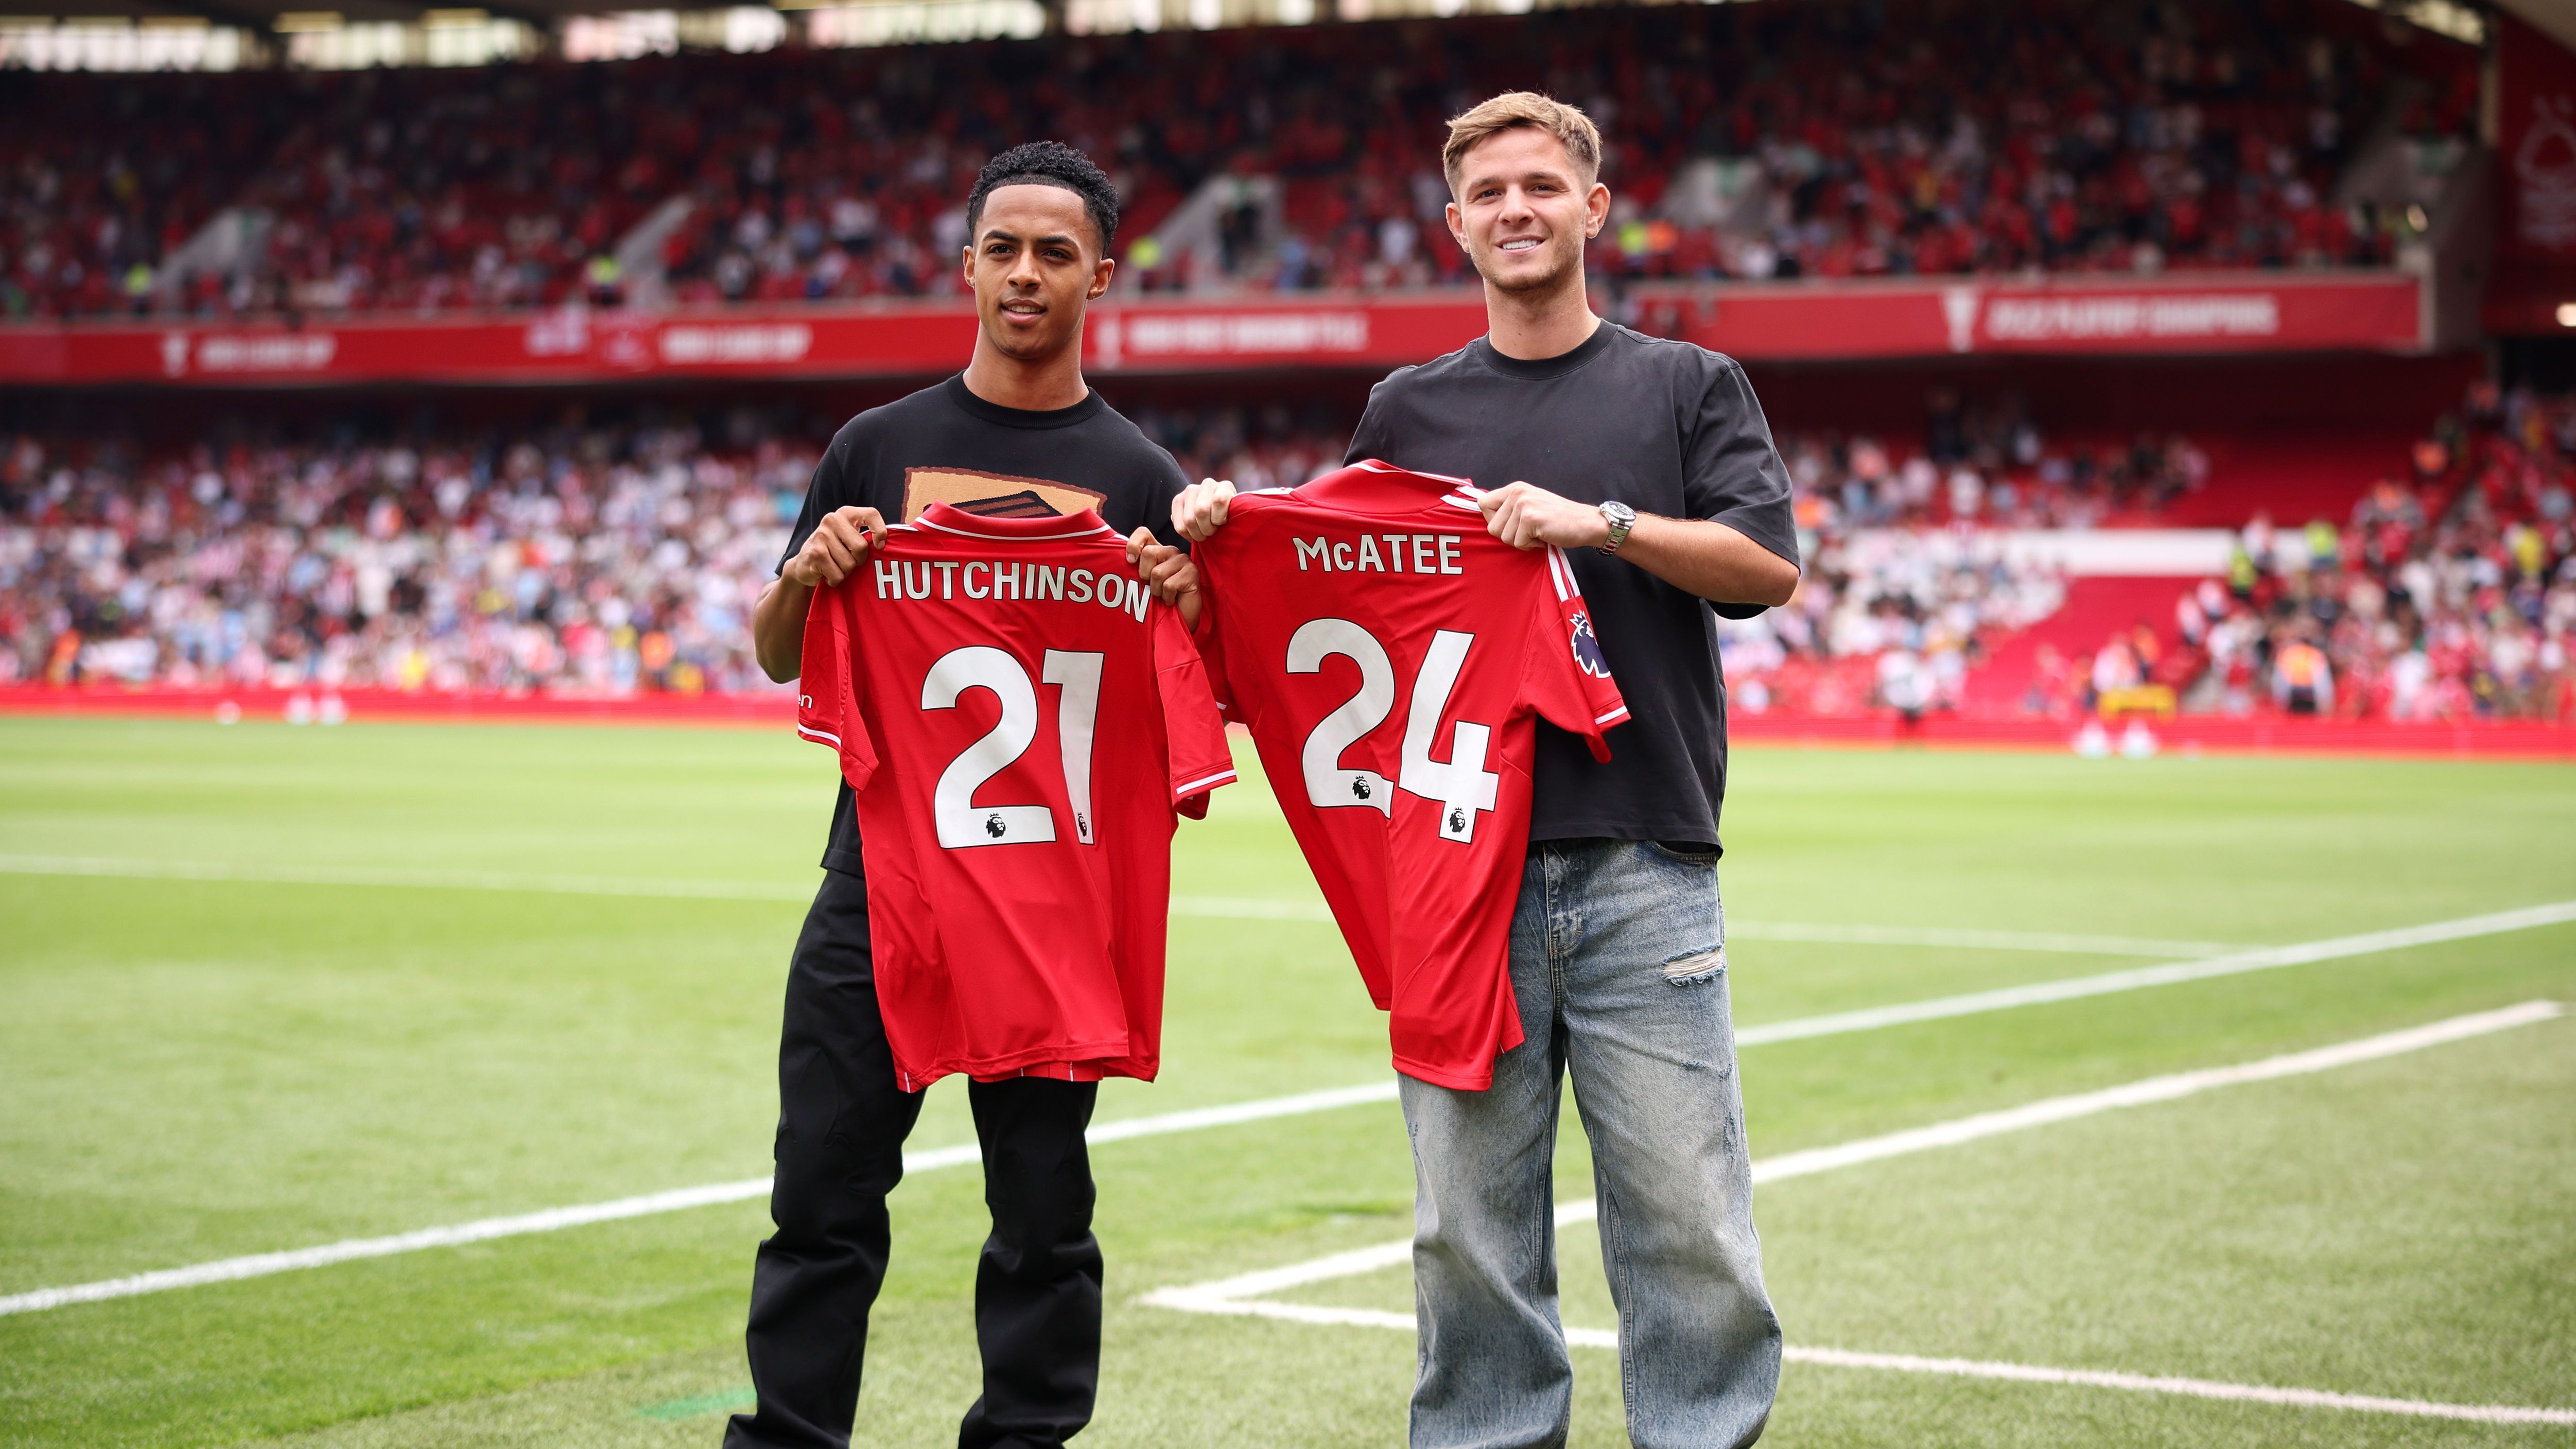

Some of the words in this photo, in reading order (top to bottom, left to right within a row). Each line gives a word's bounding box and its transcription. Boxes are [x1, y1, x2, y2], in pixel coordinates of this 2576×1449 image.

[874, 560, 1151, 623] HUTCHINSON
[1292, 534, 1464, 574] McATEE
[920, 645, 1106, 849] 21
[1286, 617, 1499, 844] 24
